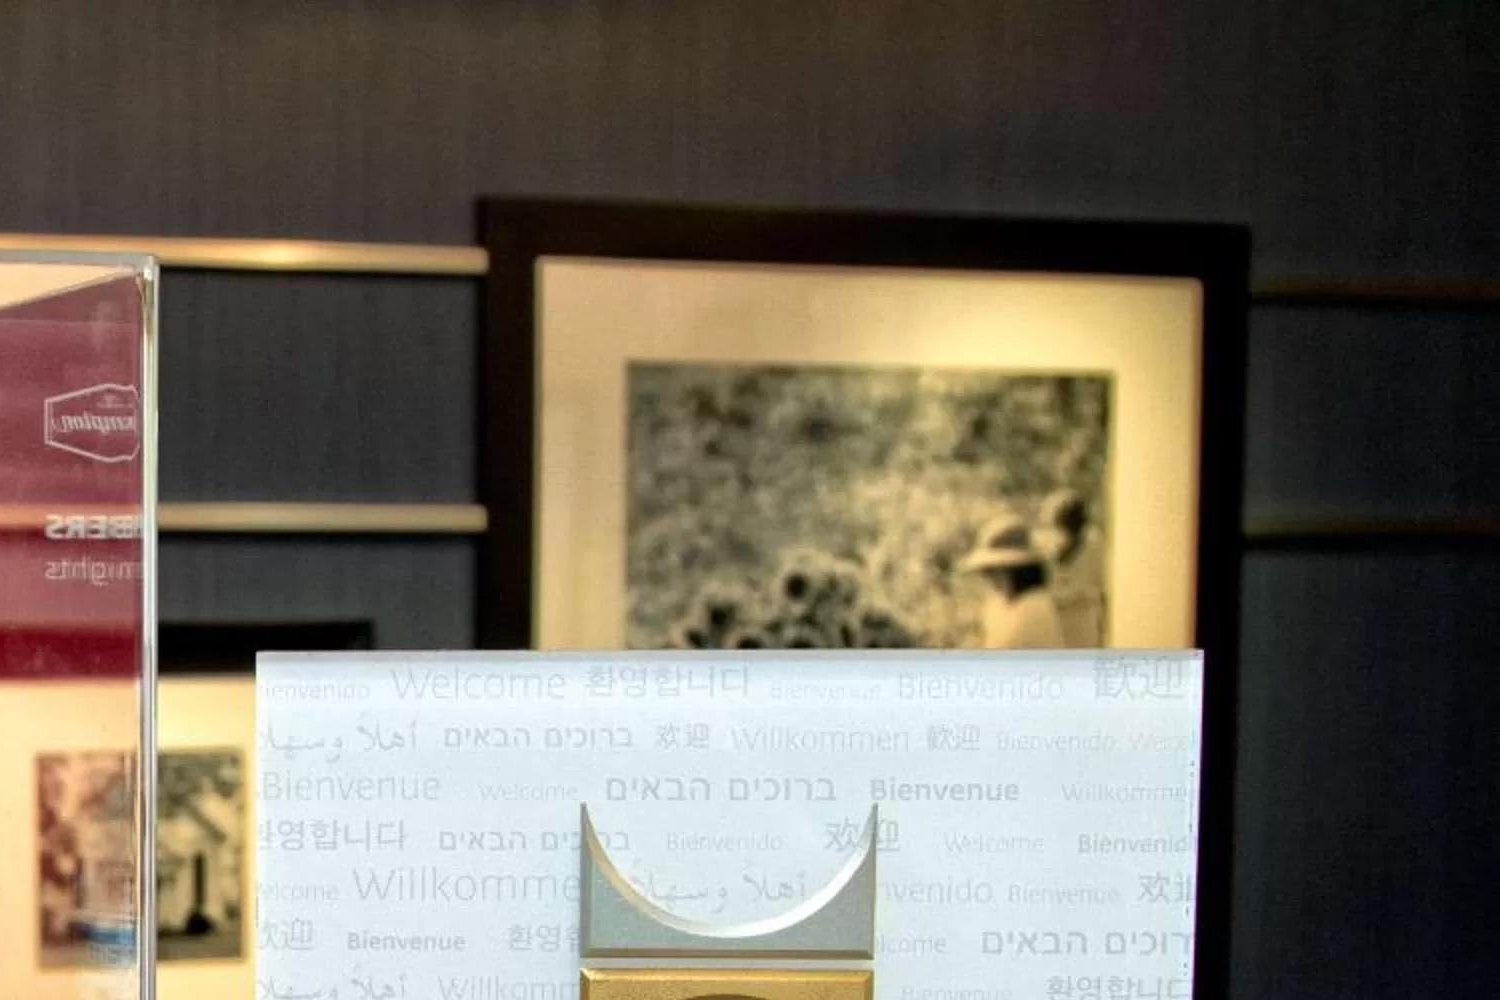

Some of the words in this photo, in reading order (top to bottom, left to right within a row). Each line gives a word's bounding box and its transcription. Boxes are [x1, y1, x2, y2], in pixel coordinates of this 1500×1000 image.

[392, 667, 566, 699] Welcome
[586, 667, 748, 697] 환영합니다
[900, 673, 1064, 701] Bienvenido
[444, 725, 530, 749] הבאים
[545, 724, 631, 749] ברוכים
[655, 723, 710, 749] 欢迎
[731, 726, 908, 754] Willkommen
[263, 771, 441, 801] Bienvenue
[606, 776, 710, 801] הבאים
[728, 777, 836, 801] ברוכים
[870, 778, 1020, 802] Bienvenue
[439, 829, 527, 852] הבאים
[1078, 834, 1189, 854] Bienvenid
[352, 867, 581, 901] Willkomme
[347, 931, 466, 952] Bienvenue
[981, 930, 1088, 955] הבאים
